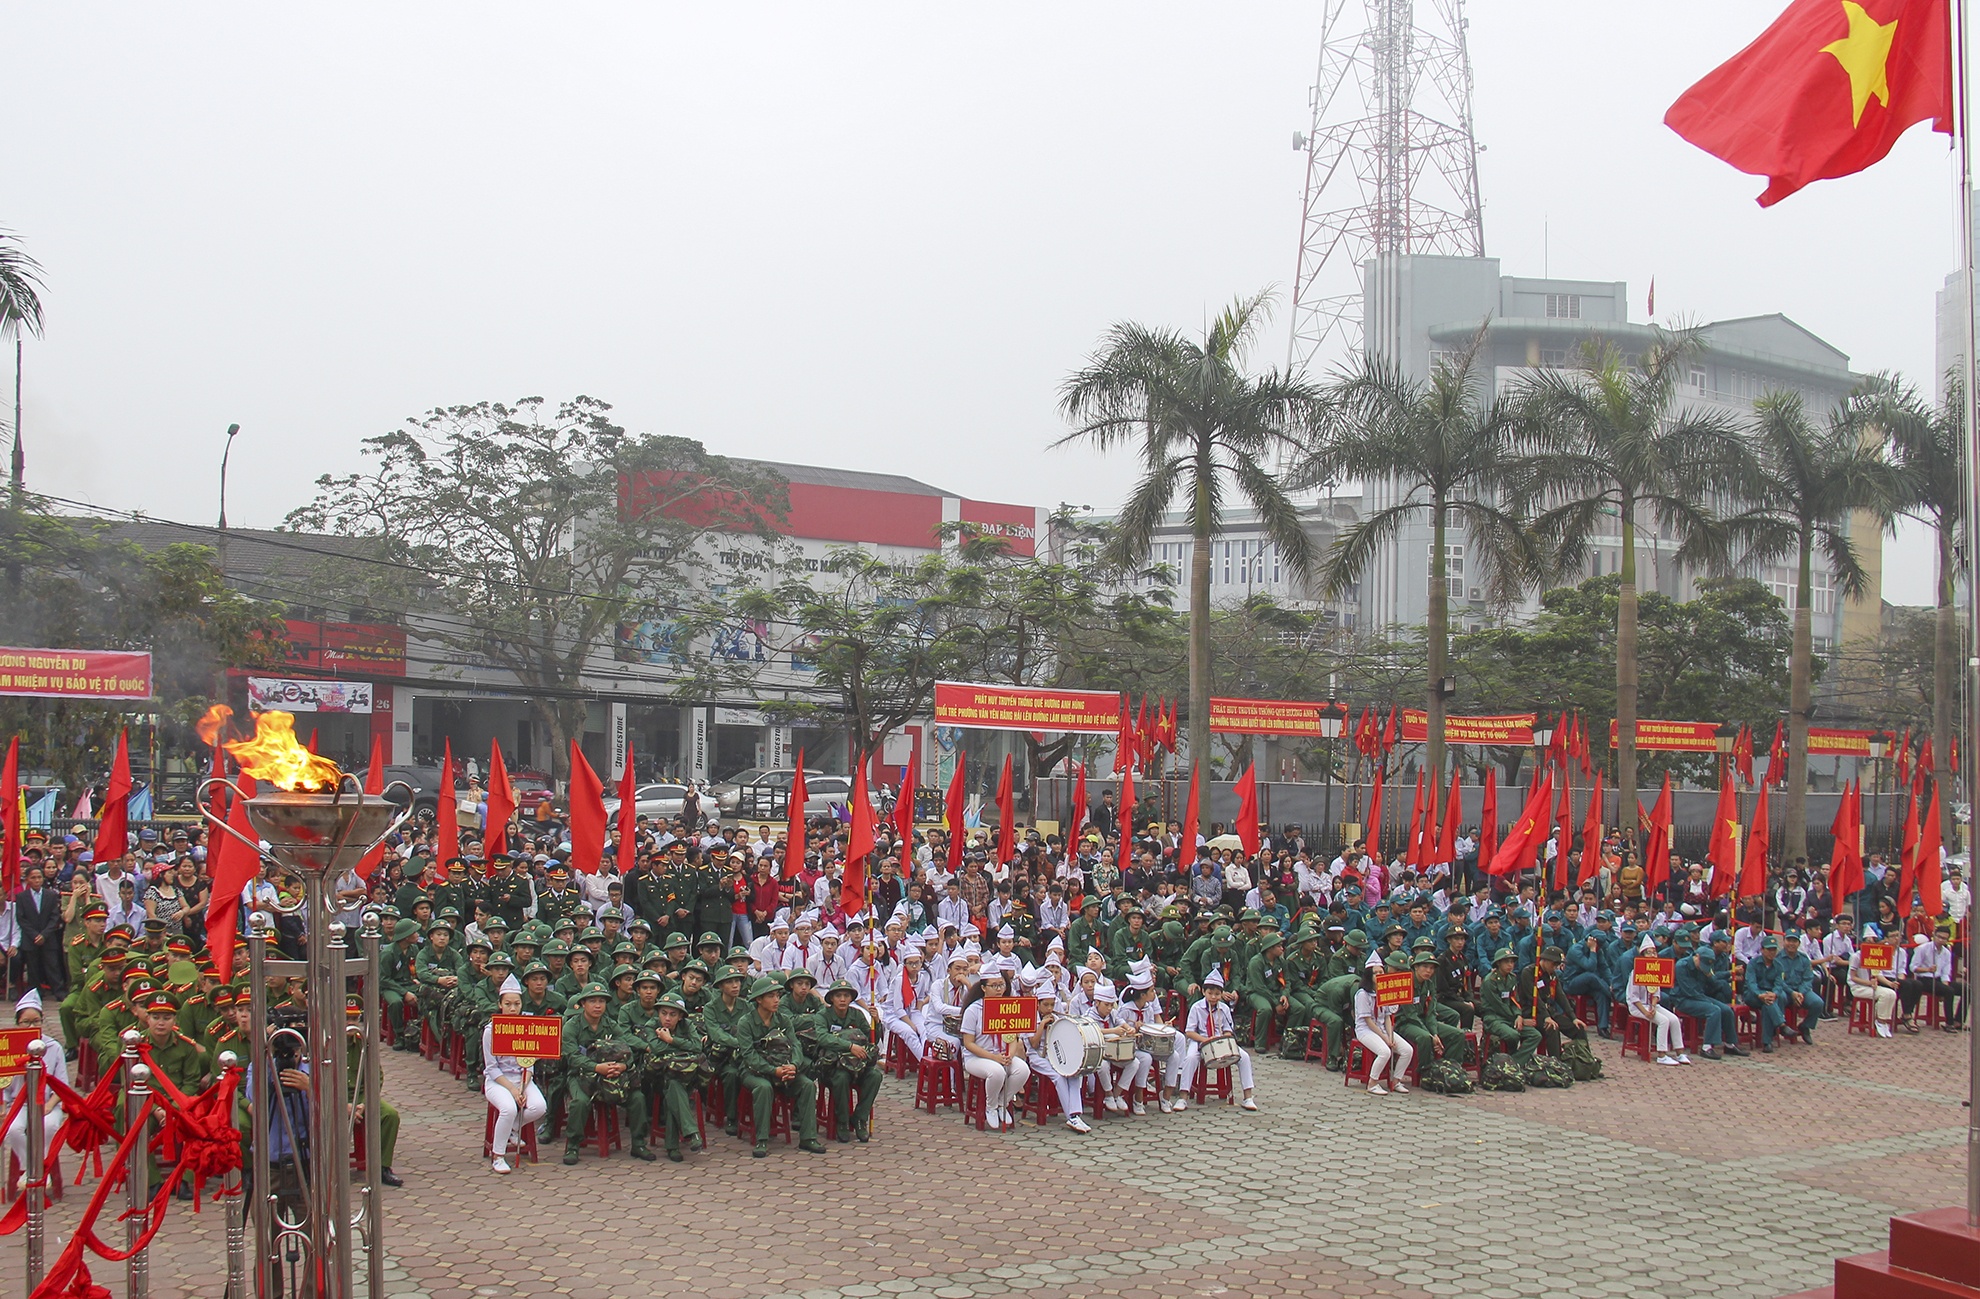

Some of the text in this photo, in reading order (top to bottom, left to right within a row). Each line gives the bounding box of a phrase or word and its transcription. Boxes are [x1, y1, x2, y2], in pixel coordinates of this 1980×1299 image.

[28, 655, 70, 670] NGUYỄN
[14, 674, 48, 690] NHIỆM
[50, 676, 63, 691] VỤ
[66, 673, 86, 690] BẢO
[89, 676, 101, 692] VỆ
[104, 675, 117, 691] TỔ
[120, 676, 144, 692] QUỐC
[376, 700, 390, 709] 26
[615, 716, 624, 768] BRIDGESTONE
[696, 718, 704, 770] BRIDGESTONE
[1000, 1000, 1021, 1014] KHỐI
[502, 1022, 514, 1034] ĐOÀN
[536, 1023, 548, 1036] ĐOÀN
[549, 1026, 558, 1036] 283
[989, 1017, 1031, 1032] HỌC SINH
[512, 1038, 540, 1051] QUÂN KHU 4
